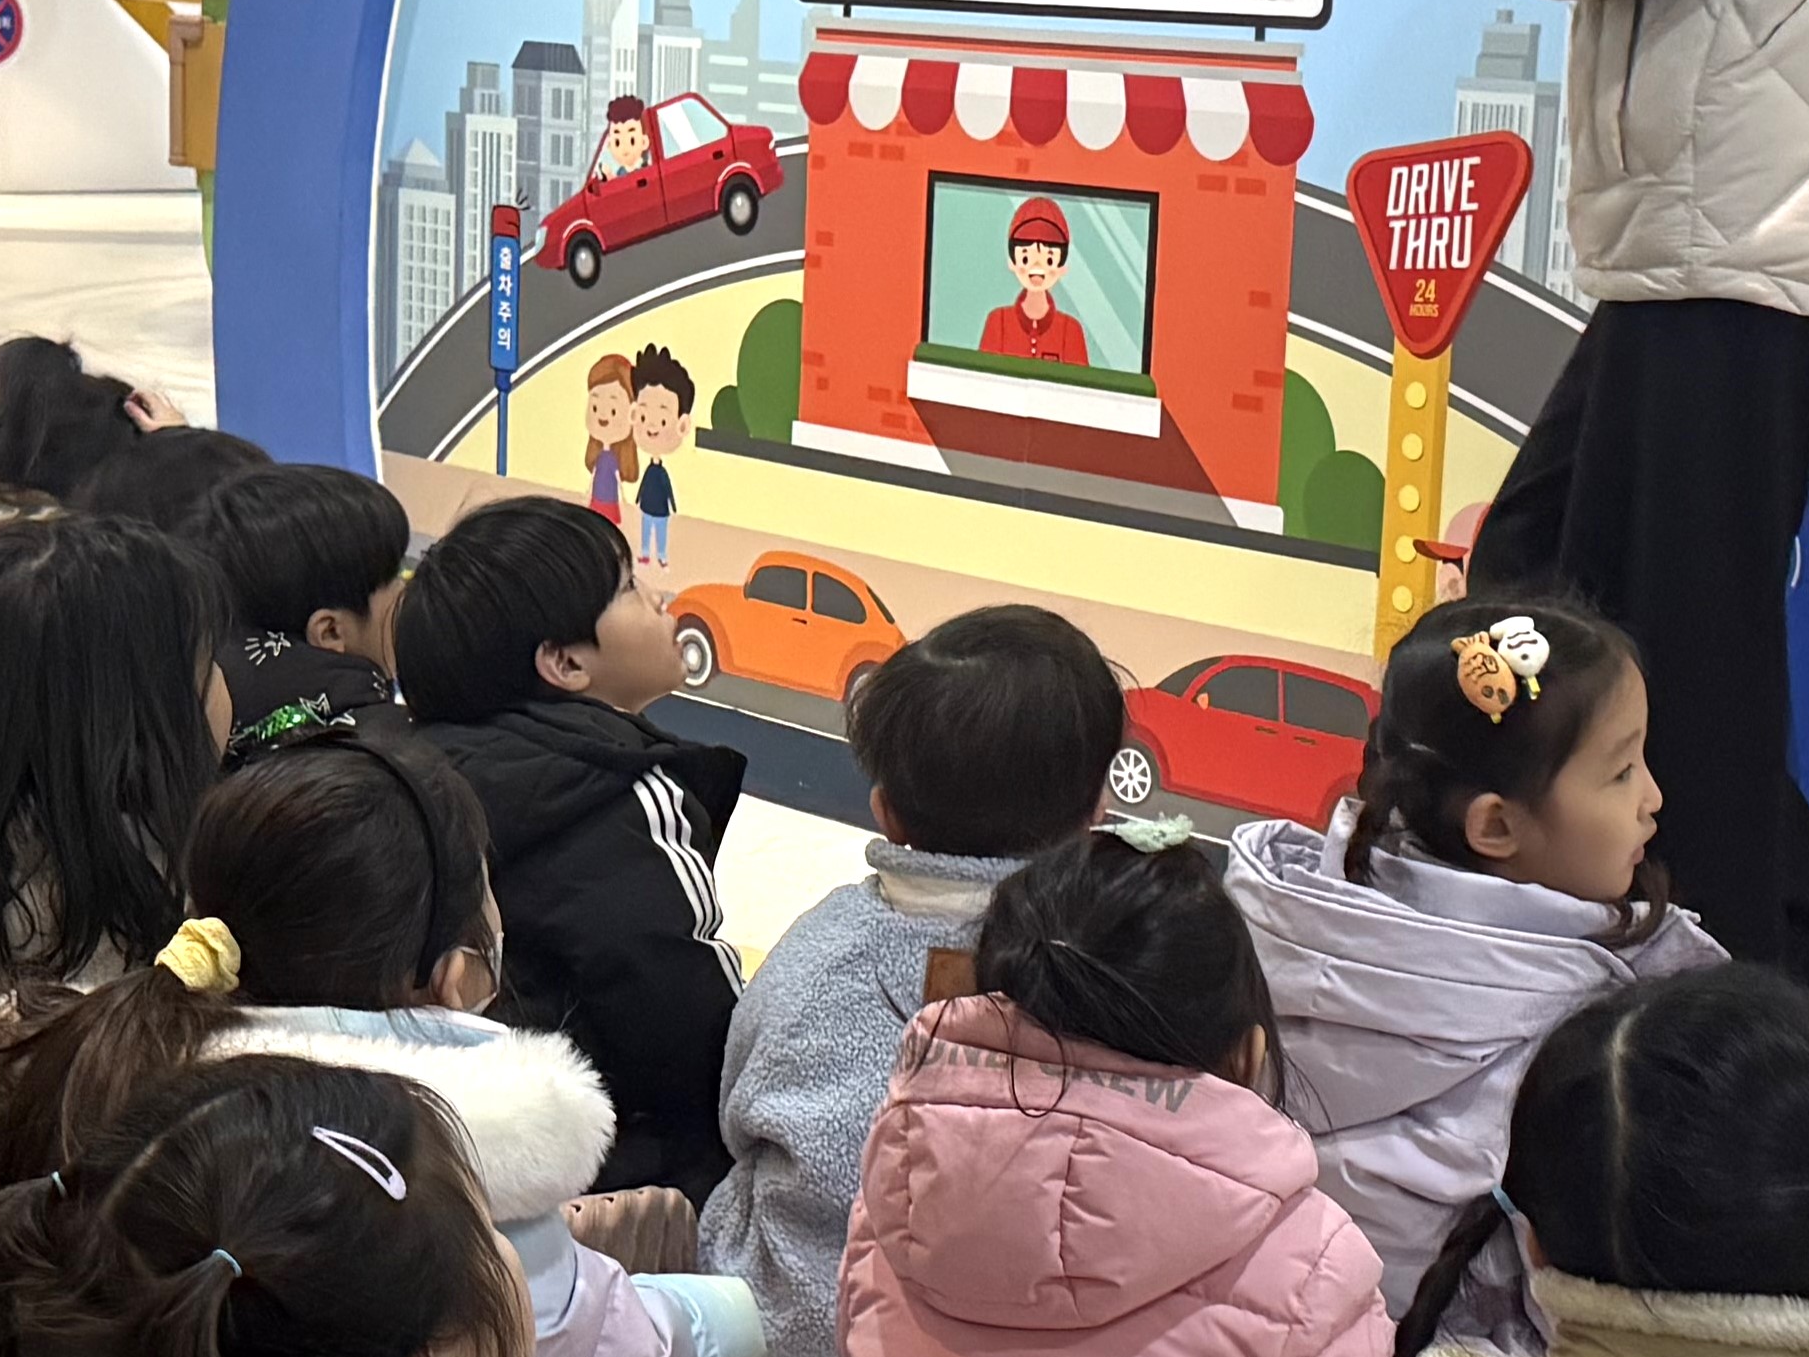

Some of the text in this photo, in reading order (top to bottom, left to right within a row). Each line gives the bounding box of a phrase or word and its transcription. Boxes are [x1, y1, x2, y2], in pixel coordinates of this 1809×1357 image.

[1386, 156, 1481, 217] DRIVE
[1388, 215, 1473, 270] THRU
[1414, 279, 1436, 302] 24
